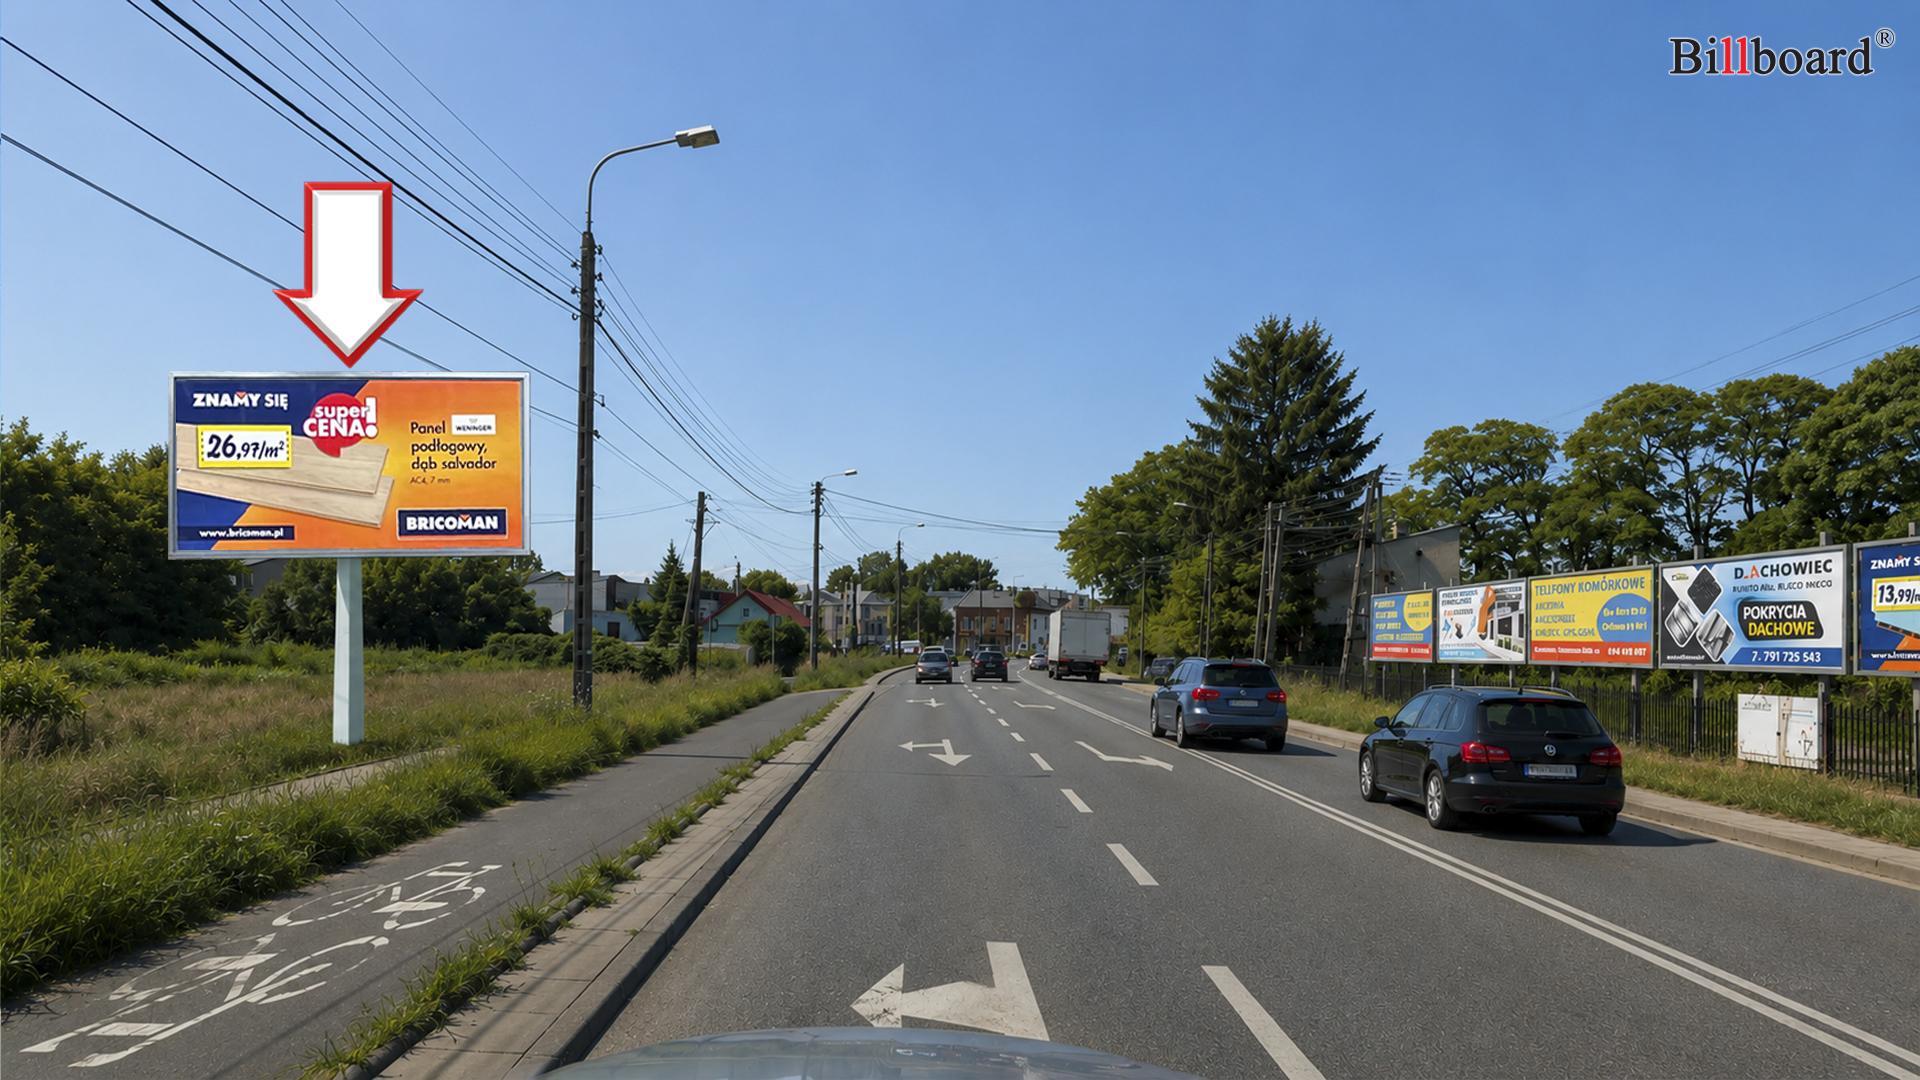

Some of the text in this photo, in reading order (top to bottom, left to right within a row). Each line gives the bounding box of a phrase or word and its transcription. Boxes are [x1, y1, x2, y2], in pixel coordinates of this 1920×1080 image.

[193, 392, 289, 410] ZNAMY SIĘ
[314, 405, 369, 421] super
[410, 420, 446, 434] Panel
[411, 438, 488, 455] podłogowy,
[411, 456, 497, 472] dąb salvador
[406, 514, 498, 531] BRICOMAN
[199, 527, 284, 539] www.bricoman.pl
[1870, 556, 1911, 570] ZNAMY
[1743, 604, 1807, 620] POKRYCIA
[1748, 621, 1815, 636] DACHOWE
